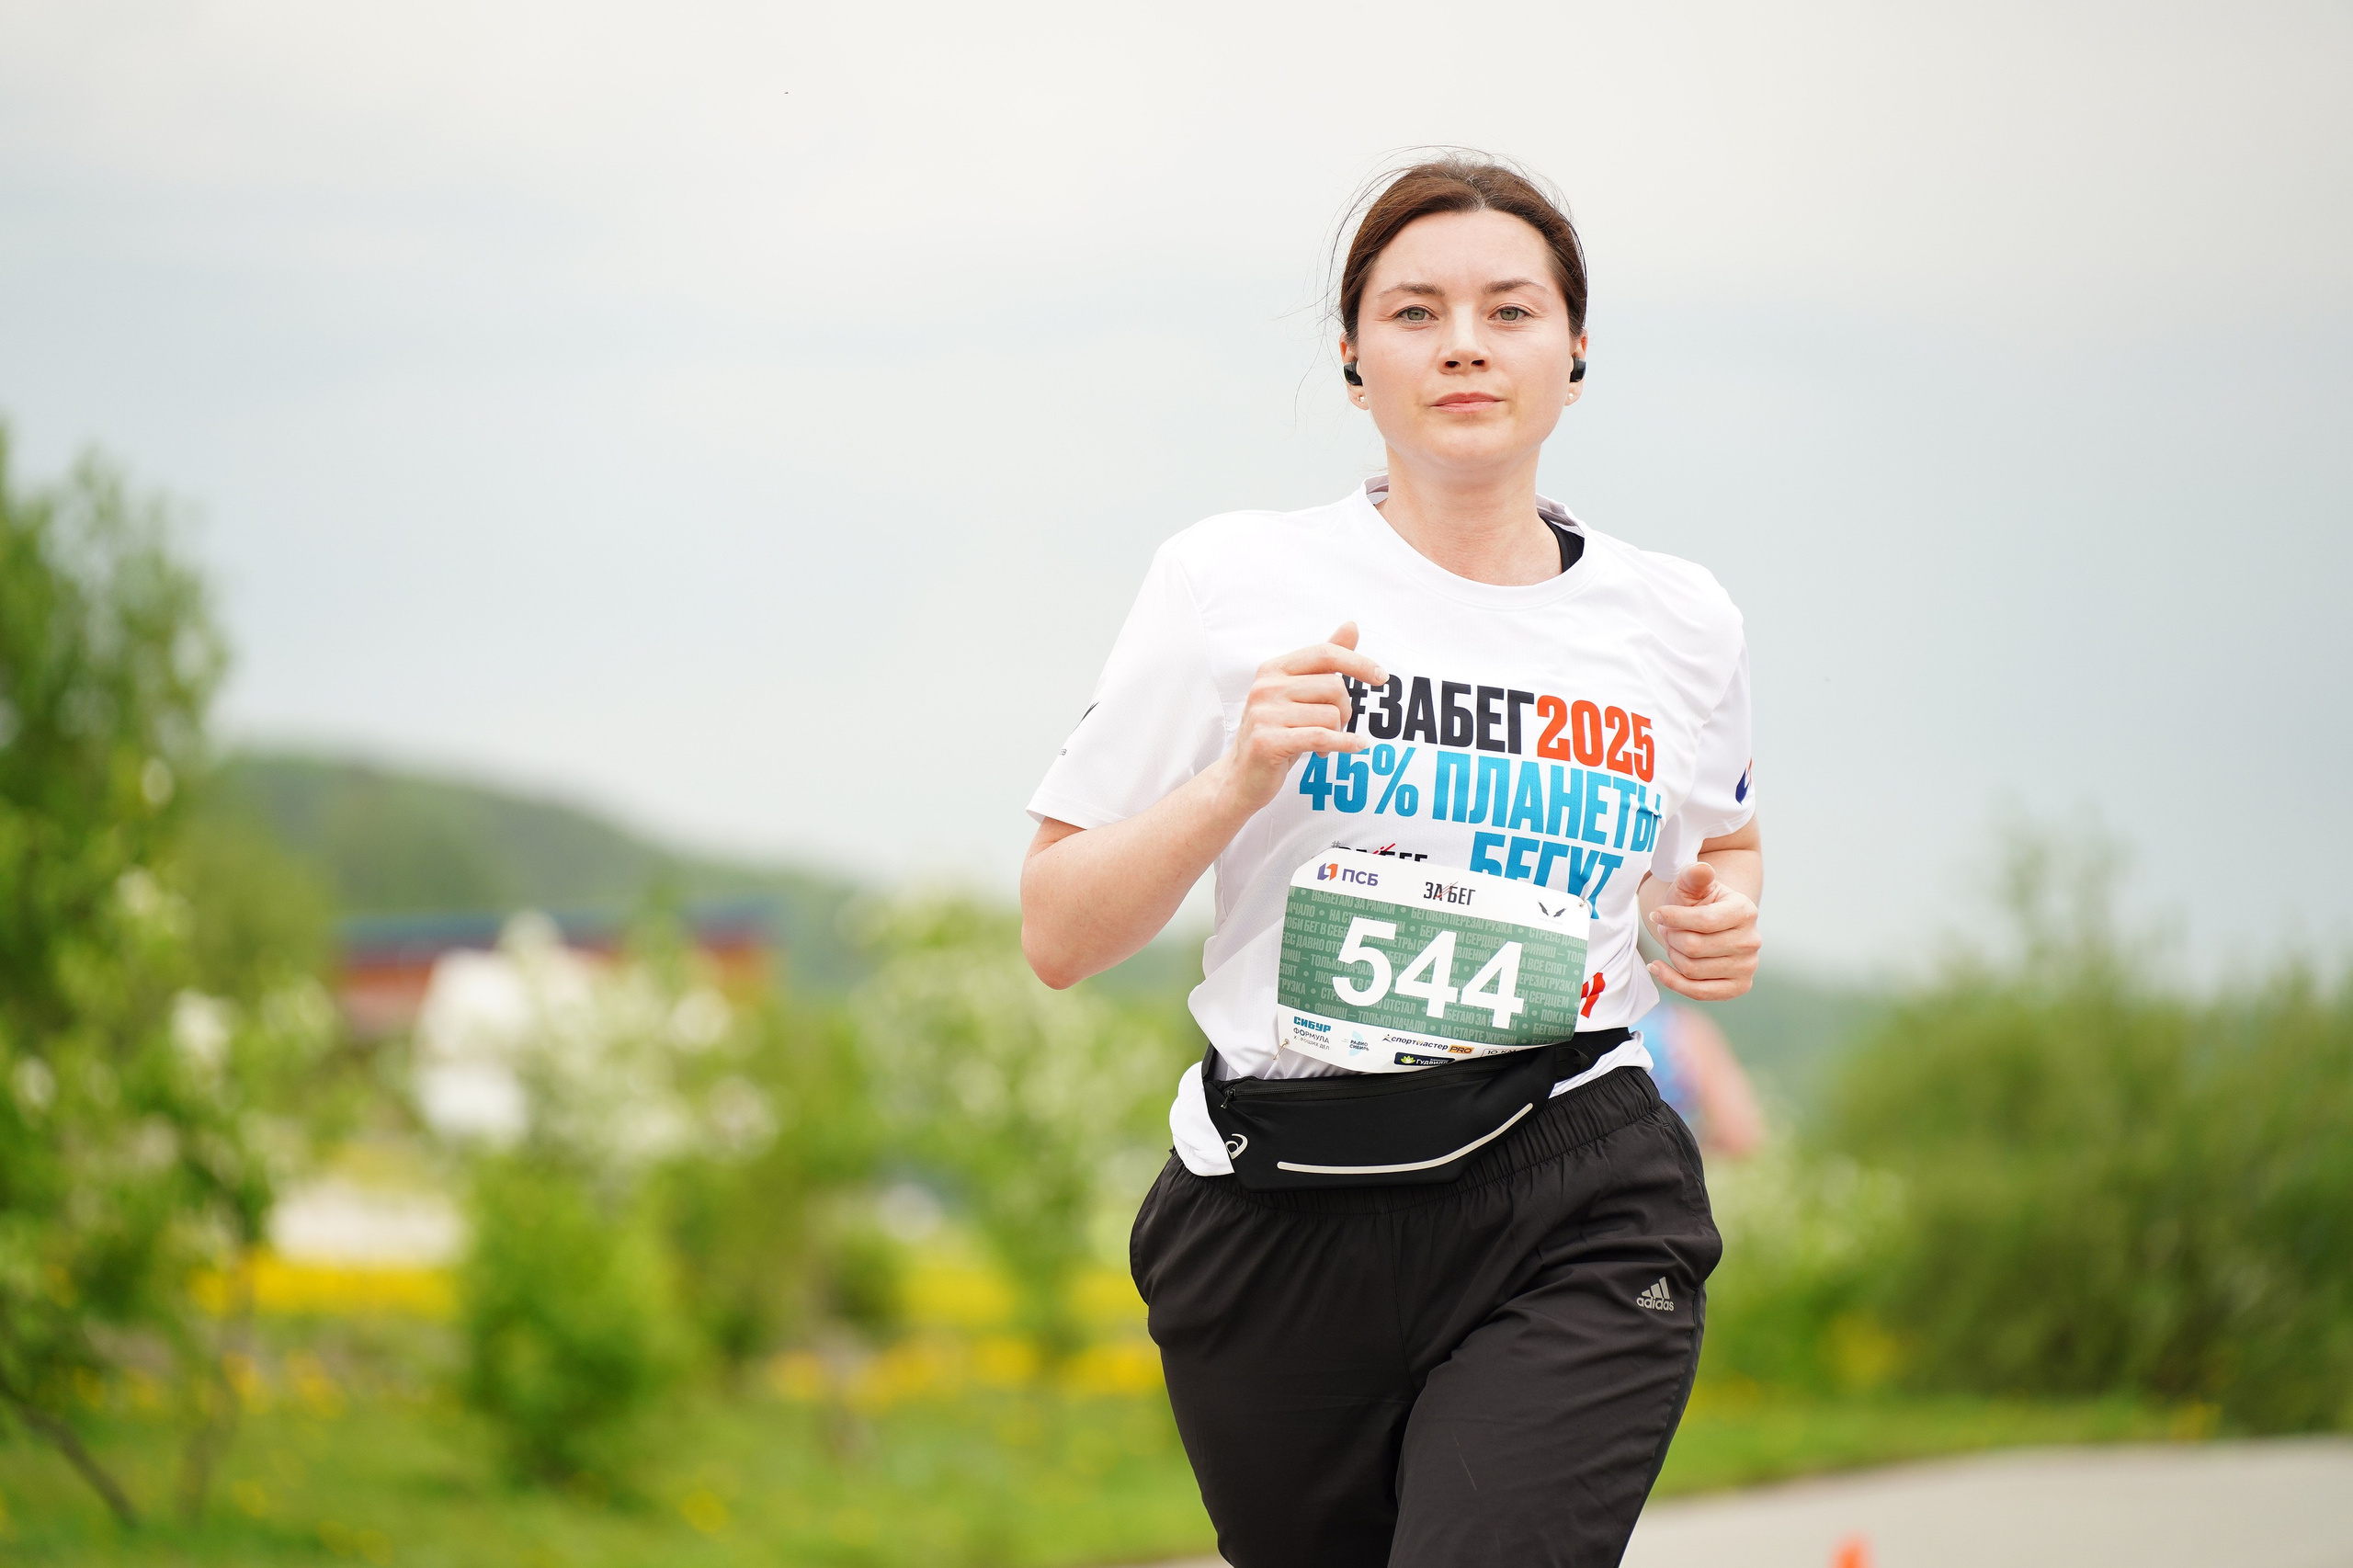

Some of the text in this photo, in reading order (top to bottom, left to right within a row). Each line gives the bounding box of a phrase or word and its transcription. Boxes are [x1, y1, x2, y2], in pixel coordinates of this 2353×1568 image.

[1299, 743, 1663, 853] 45% ПЛАНЕТЫ
[1341, 869, 1379, 887] ПСБ
[1311, 890, 1354, 908] ВЫБЕГАЮ
[1354, 897, 1365, 910] ЗА
[1365, 900, 1395, 915] РАМКИ
[1411, 908, 1449, 924] БЕГОВАЯ
[1449, 913, 1513, 935] ПЕРЕЗАГРУЗКА
[1529, 928, 1562, 944] СТРЕСС
[1329, 908, 1341, 923] НА
[1522, 941, 1557, 959] ФИНИШ
[1296, 934, 1324, 951] ДАВНО
[1303, 919, 1321, 933] БЕГ
[1320, 922, 1326, 935] В
[1527, 958, 1545, 972] ВСЕ
[1545, 960, 1568, 976] СПЯТ
[1311, 953, 1344, 971] ТОЛЬКО
[1529, 990, 1570, 1009] СЕРДЦЕМ
[1332, 916, 1525, 1029] 544
[1293, 1016, 1332, 1032] СИБУР
[1293, 1027, 1331, 1044] ФОРМУЛА
[1314, 1002, 1348, 1020] ФИНИШ
[1358, 1010, 1392, 1028] ТОЛЬКО
[1392, 1016, 1427, 1034] НАЧАЛО
[1439, 1024, 1452, 1038] НА
[1452, 1026, 1485, 1043] СТАРТЕ
[1483, 1030, 1518, 1046] ЖИЗНИ
[1383, 998, 1417, 1016] ОТСТАЛ
[1475, 1013, 1486, 1027] ЗА
[1532, 1022, 1572, 1037] БЕГОВАЯ
[1540, 1009, 1564, 1025] ПОКА
[1449, 1046, 1472, 1054] PRO
[1636, 1296, 1675, 1312] adidas
